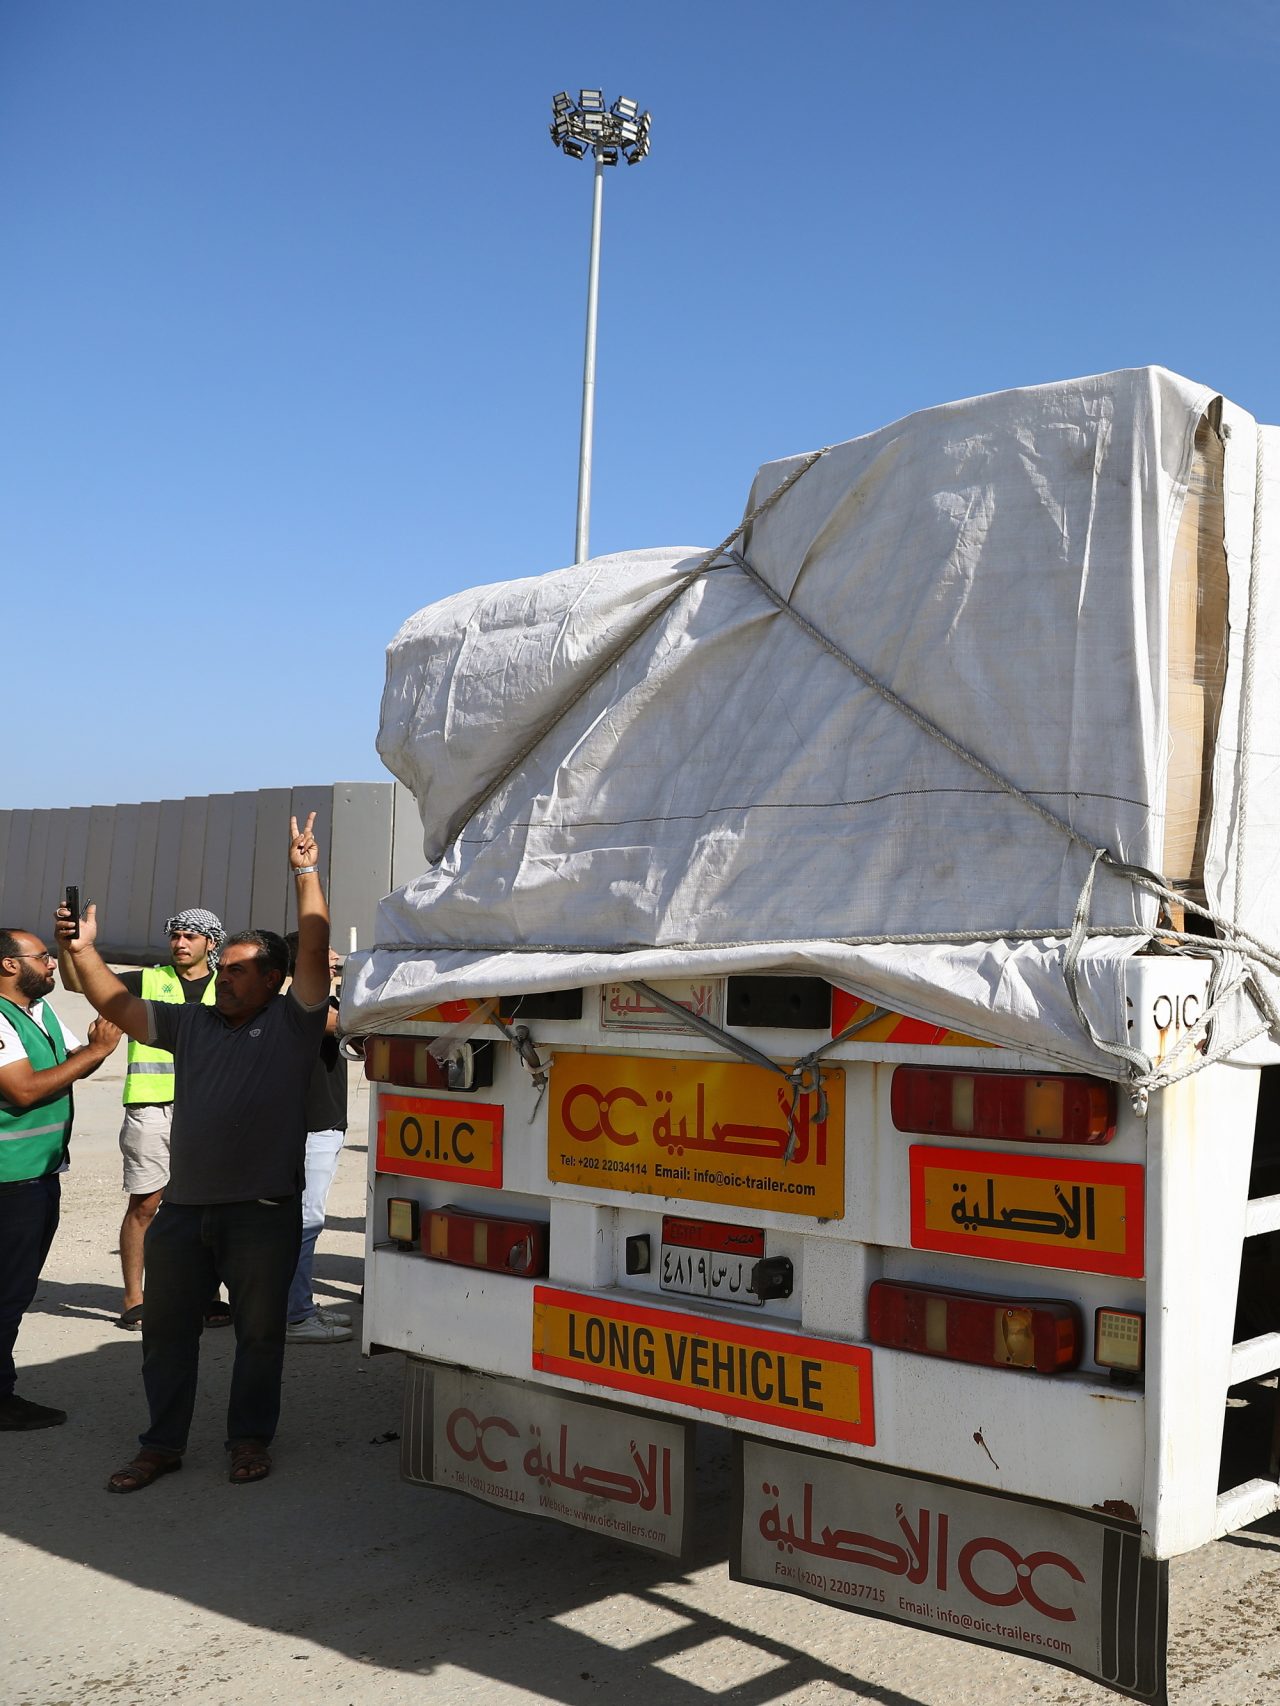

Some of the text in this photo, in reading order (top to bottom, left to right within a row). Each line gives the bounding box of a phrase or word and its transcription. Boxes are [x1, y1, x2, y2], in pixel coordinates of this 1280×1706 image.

[400, 1116, 475, 1164] O.I.C
[652, 1083, 828, 1166] الأصلية
[560, 1154, 816, 1196] Tel: +202 22034114 Email: info@oic-trailer.com
[951, 1179, 1096, 1241] الأصلية
[721, 1234, 755, 1245] مصر
[568, 1314, 824, 1411] LONG VEHICLE
[454, 1470, 467, 1483] Tel:
[539, 1494, 572, 1518] Website:
[573, 1508, 667, 1545] www.oic-trailers.com
[523, 1424, 672, 1516] الأصلية
[759, 1483, 949, 1591] الأصلية
[774, 1562, 796, 1579] Fax:
[797, 1565, 828, 1593] (+202)
[829, 1578, 886, 1603] 22037715
[898, 1595, 934, 1618] Email:
[936, 1608, 1072, 1655] info@oic-trailers.com
